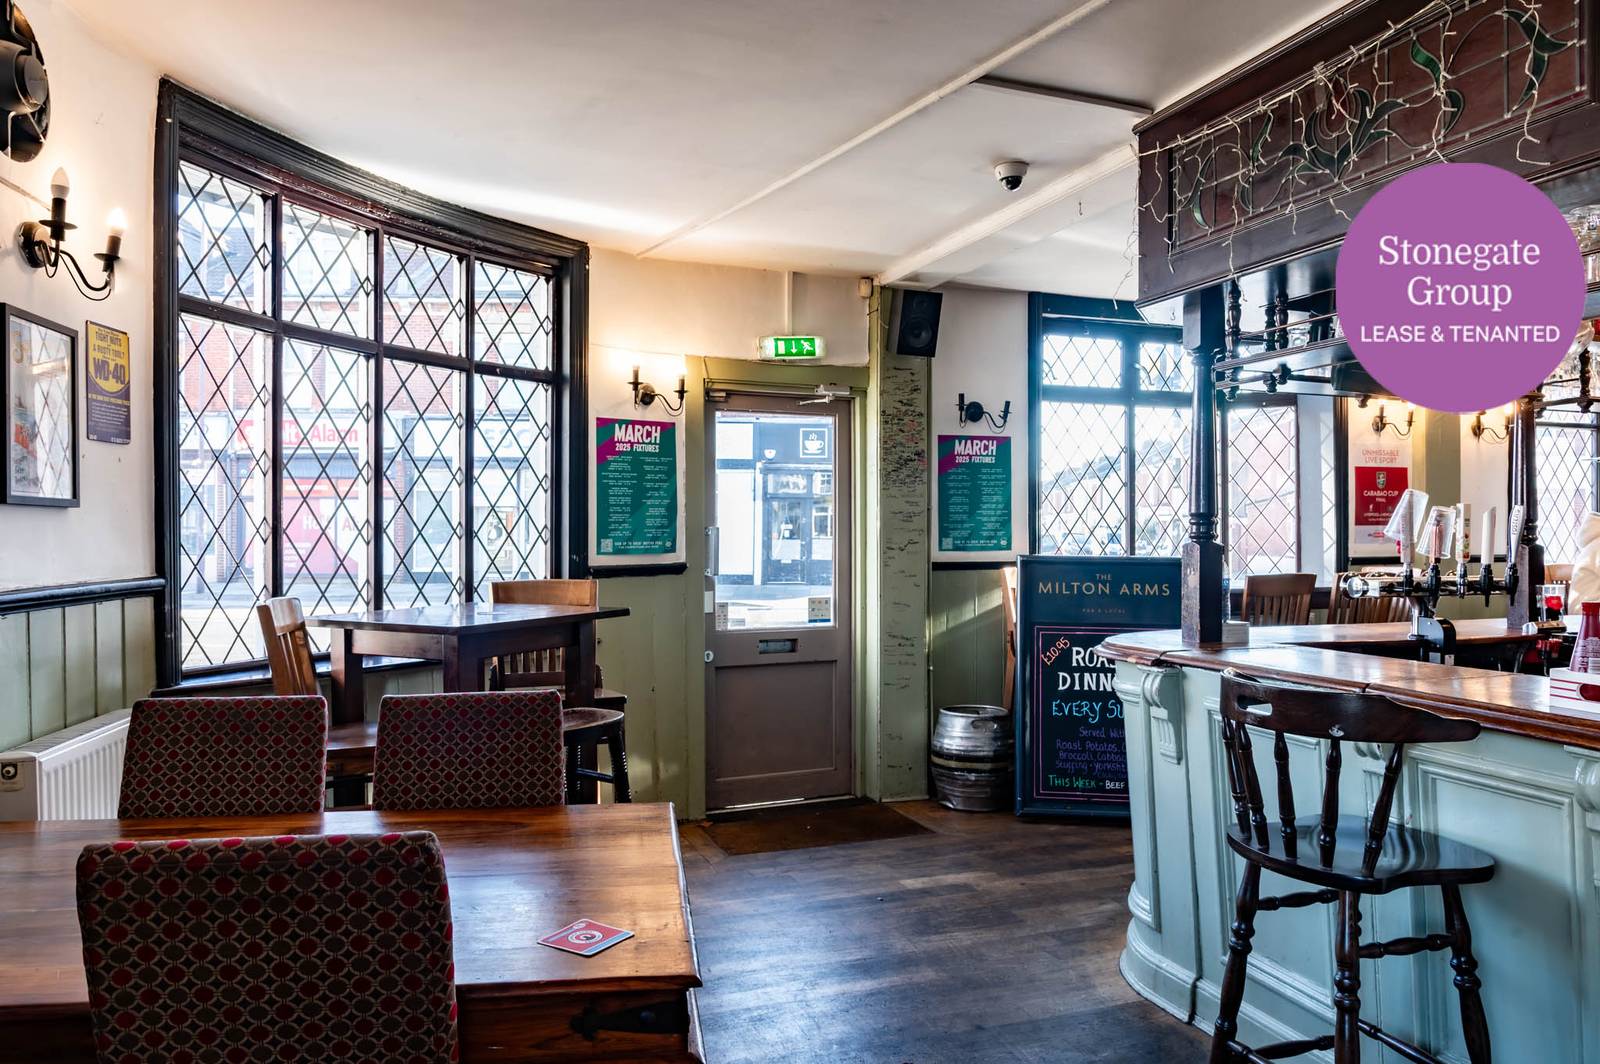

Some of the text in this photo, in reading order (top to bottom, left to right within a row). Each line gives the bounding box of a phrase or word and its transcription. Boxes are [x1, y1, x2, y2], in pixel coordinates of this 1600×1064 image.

[614, 423, 661, 443] MARCH
[615, 443, 659, 452] 2025 FIXTURES
[954, 439, 996, 455] MARCH
[1096, 573, 1112, 581] THE
[1038, 582, 1171, 596] MILTON ARMS
[1041, 636, 1070, 666] £10.95
[1052, 699, 1102, 724] EVERY
